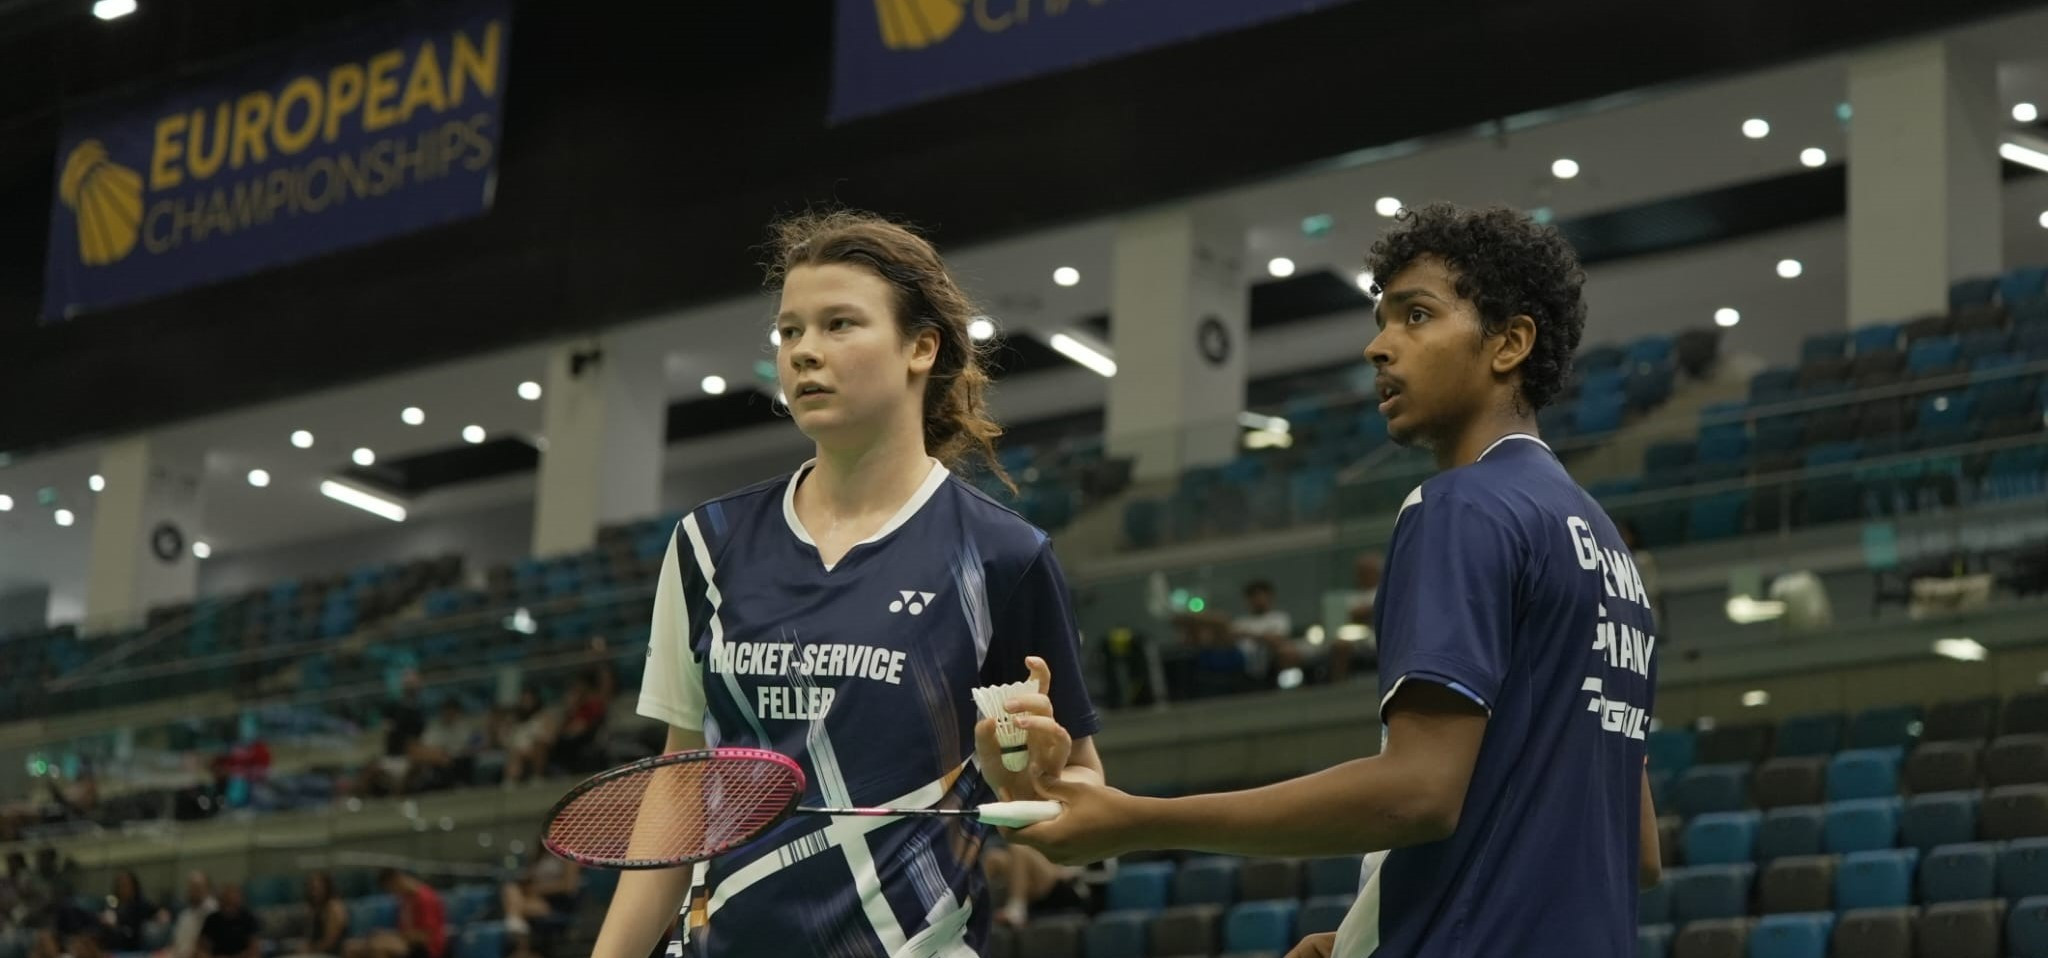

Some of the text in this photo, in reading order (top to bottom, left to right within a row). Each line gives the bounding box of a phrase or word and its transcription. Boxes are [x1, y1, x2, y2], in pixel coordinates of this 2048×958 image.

[149, 19, 502, 191] EUROPEAN
[143, 112, 494, 256] CHAMPIONSHIPS
[709, 641, 907, 685] RACKET-SERVICE
[757, 686, 837, 721] FELLER
